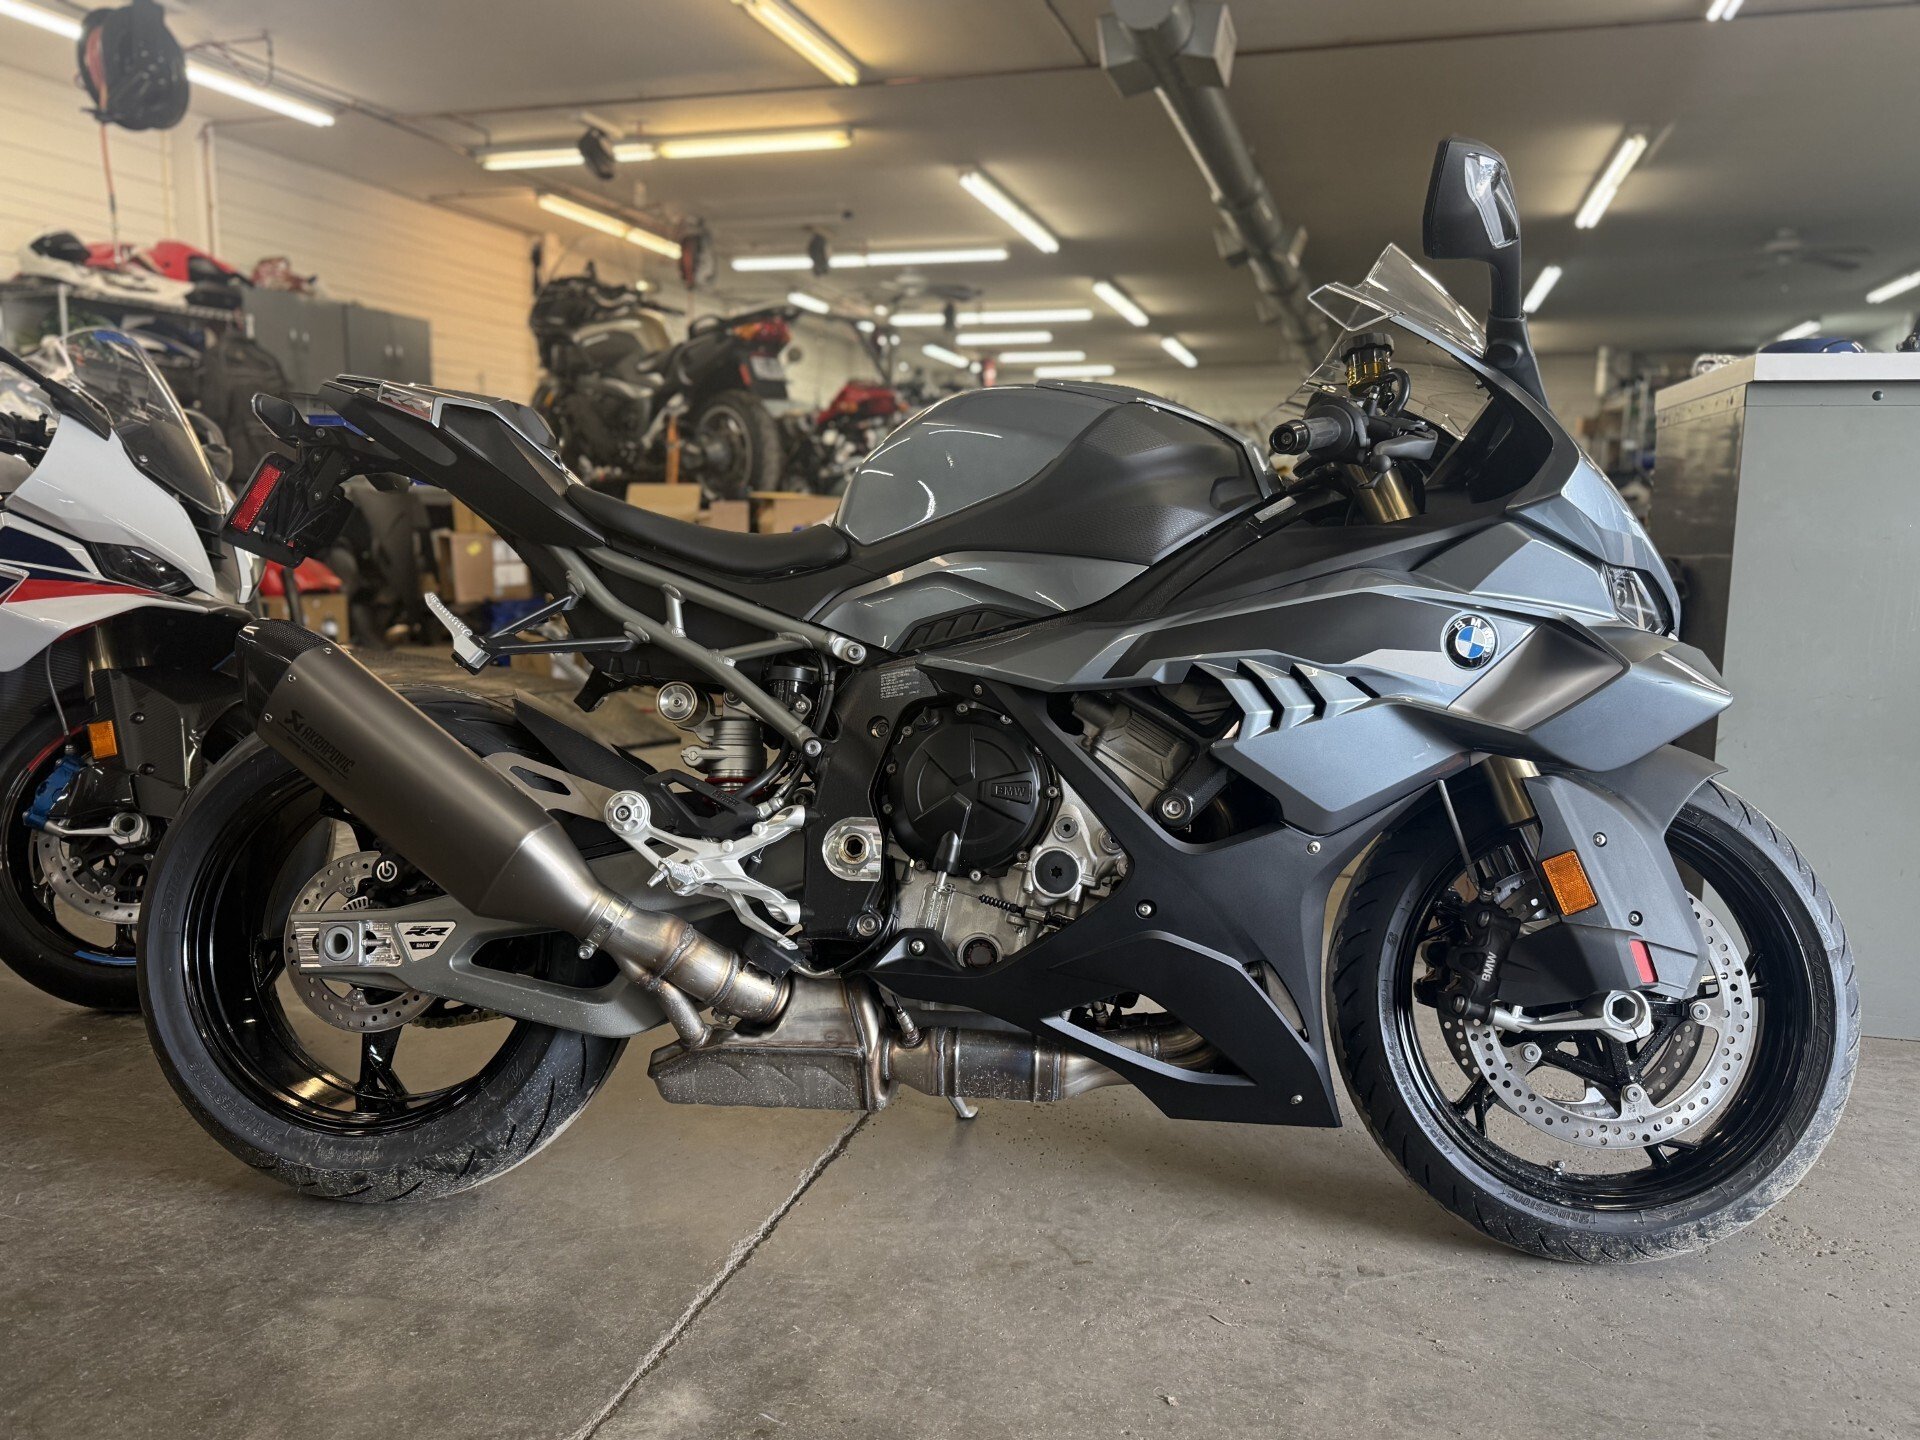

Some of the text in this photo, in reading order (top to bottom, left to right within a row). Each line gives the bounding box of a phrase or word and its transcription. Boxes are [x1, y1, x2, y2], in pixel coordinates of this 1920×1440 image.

[995, 785, 1025, 797] BMW
[404, 927, 450, 936] RR
[1481, 951, 1497, 982] BMW
[1506, 1190, 1590, 1224] BRIDGESTONE
